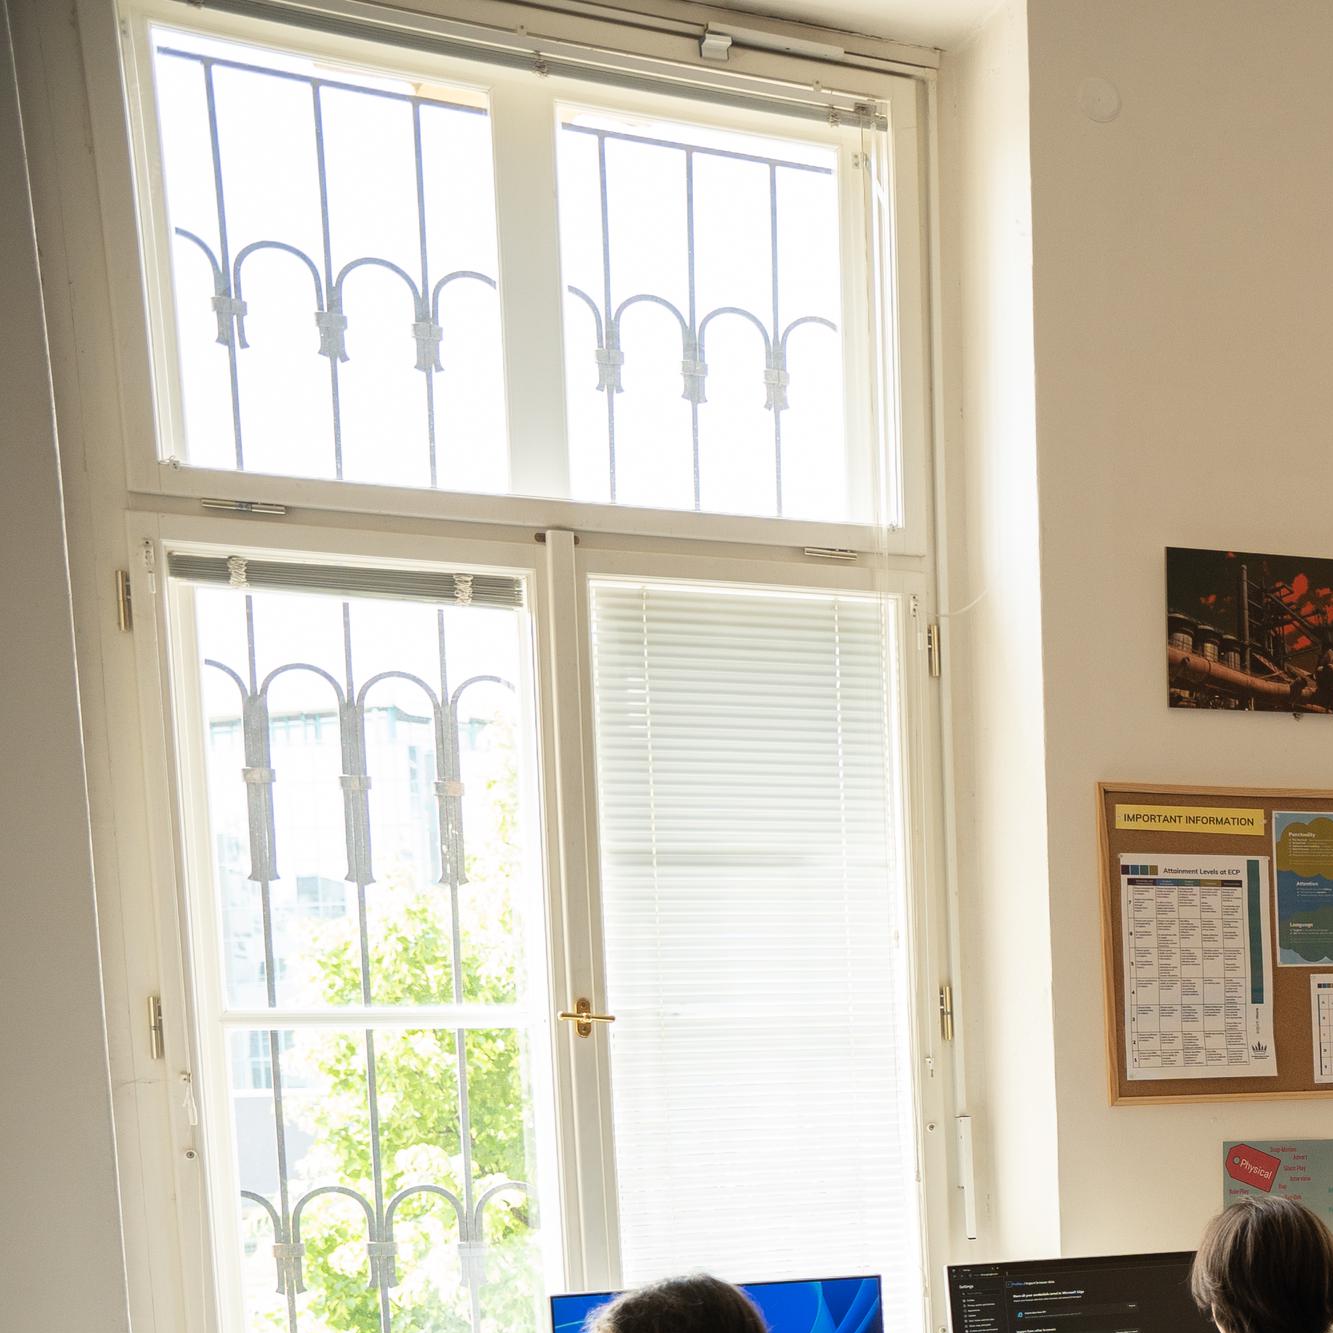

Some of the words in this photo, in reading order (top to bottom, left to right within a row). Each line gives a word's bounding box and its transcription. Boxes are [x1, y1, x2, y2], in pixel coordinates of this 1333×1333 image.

[1124, 814, 1183, 824] IMPORTANT
[1186, 816, 1254, 826] INFORMATION
[1200, 868, 1219, 876] Levels
[1240, 1158, 1272, 1180] Physical
